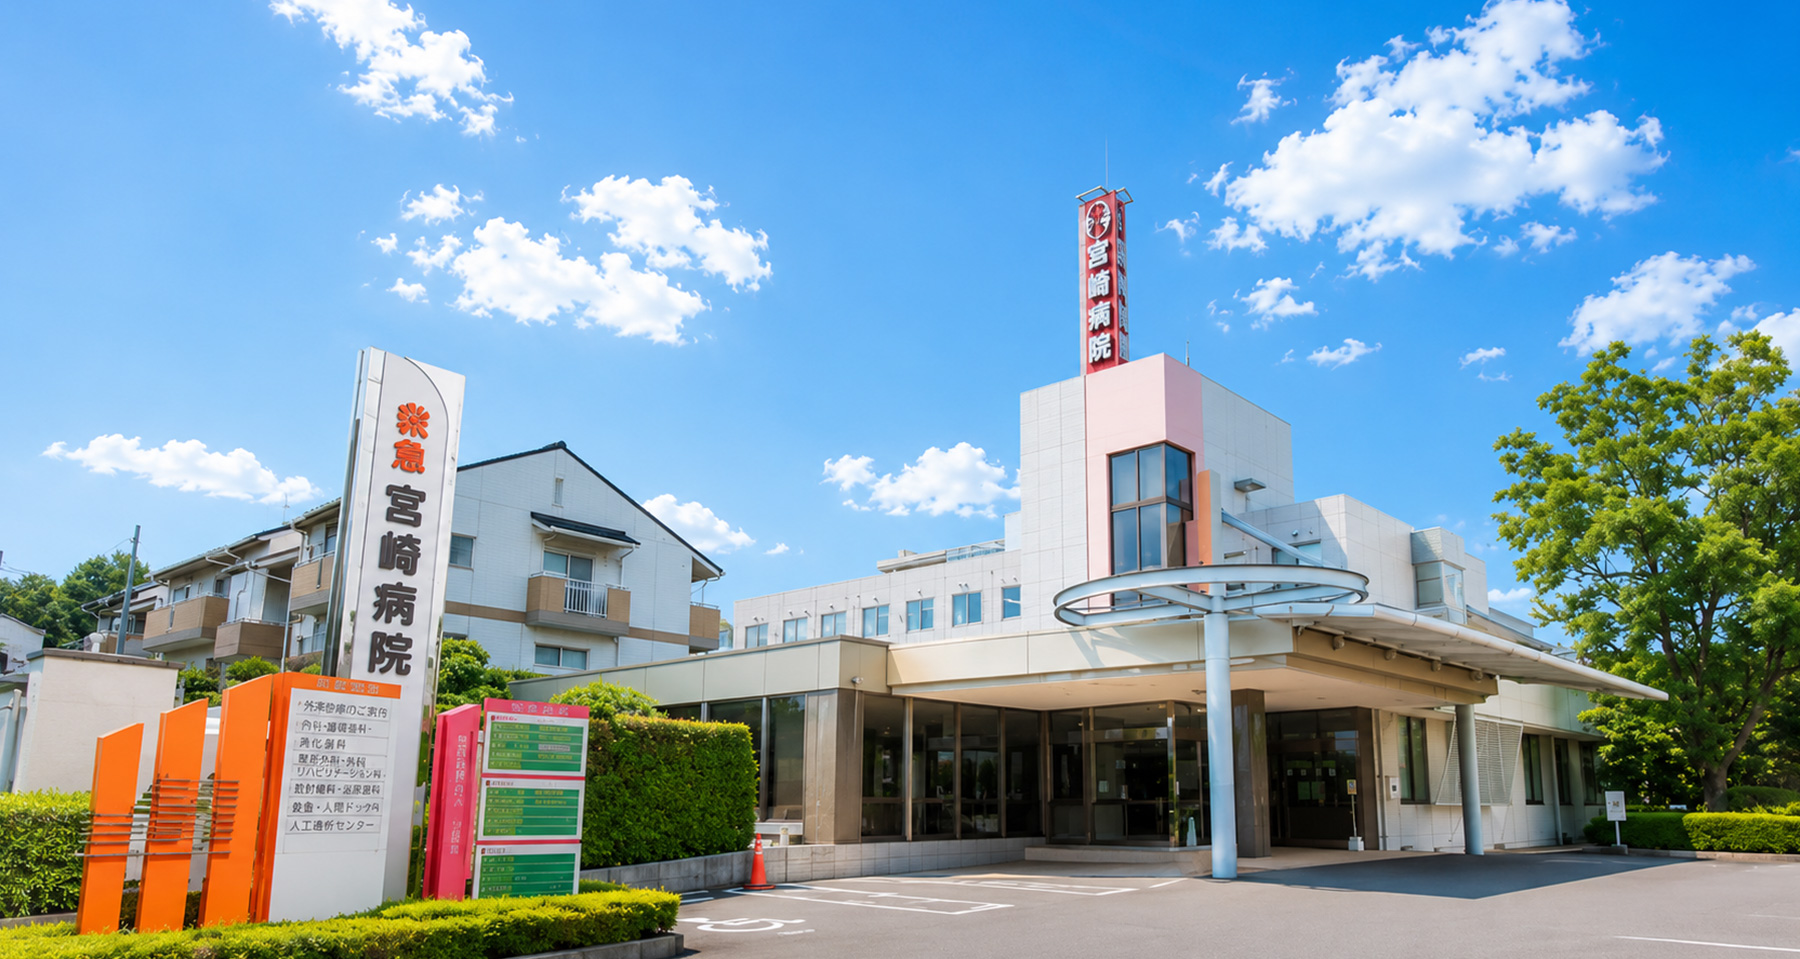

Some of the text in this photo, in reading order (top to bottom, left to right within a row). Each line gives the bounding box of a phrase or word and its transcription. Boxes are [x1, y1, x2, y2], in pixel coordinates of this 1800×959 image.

[1087, 239, 1111, 364] 宮崎病院
[368, 484, 426, 676] 宮崎病院
